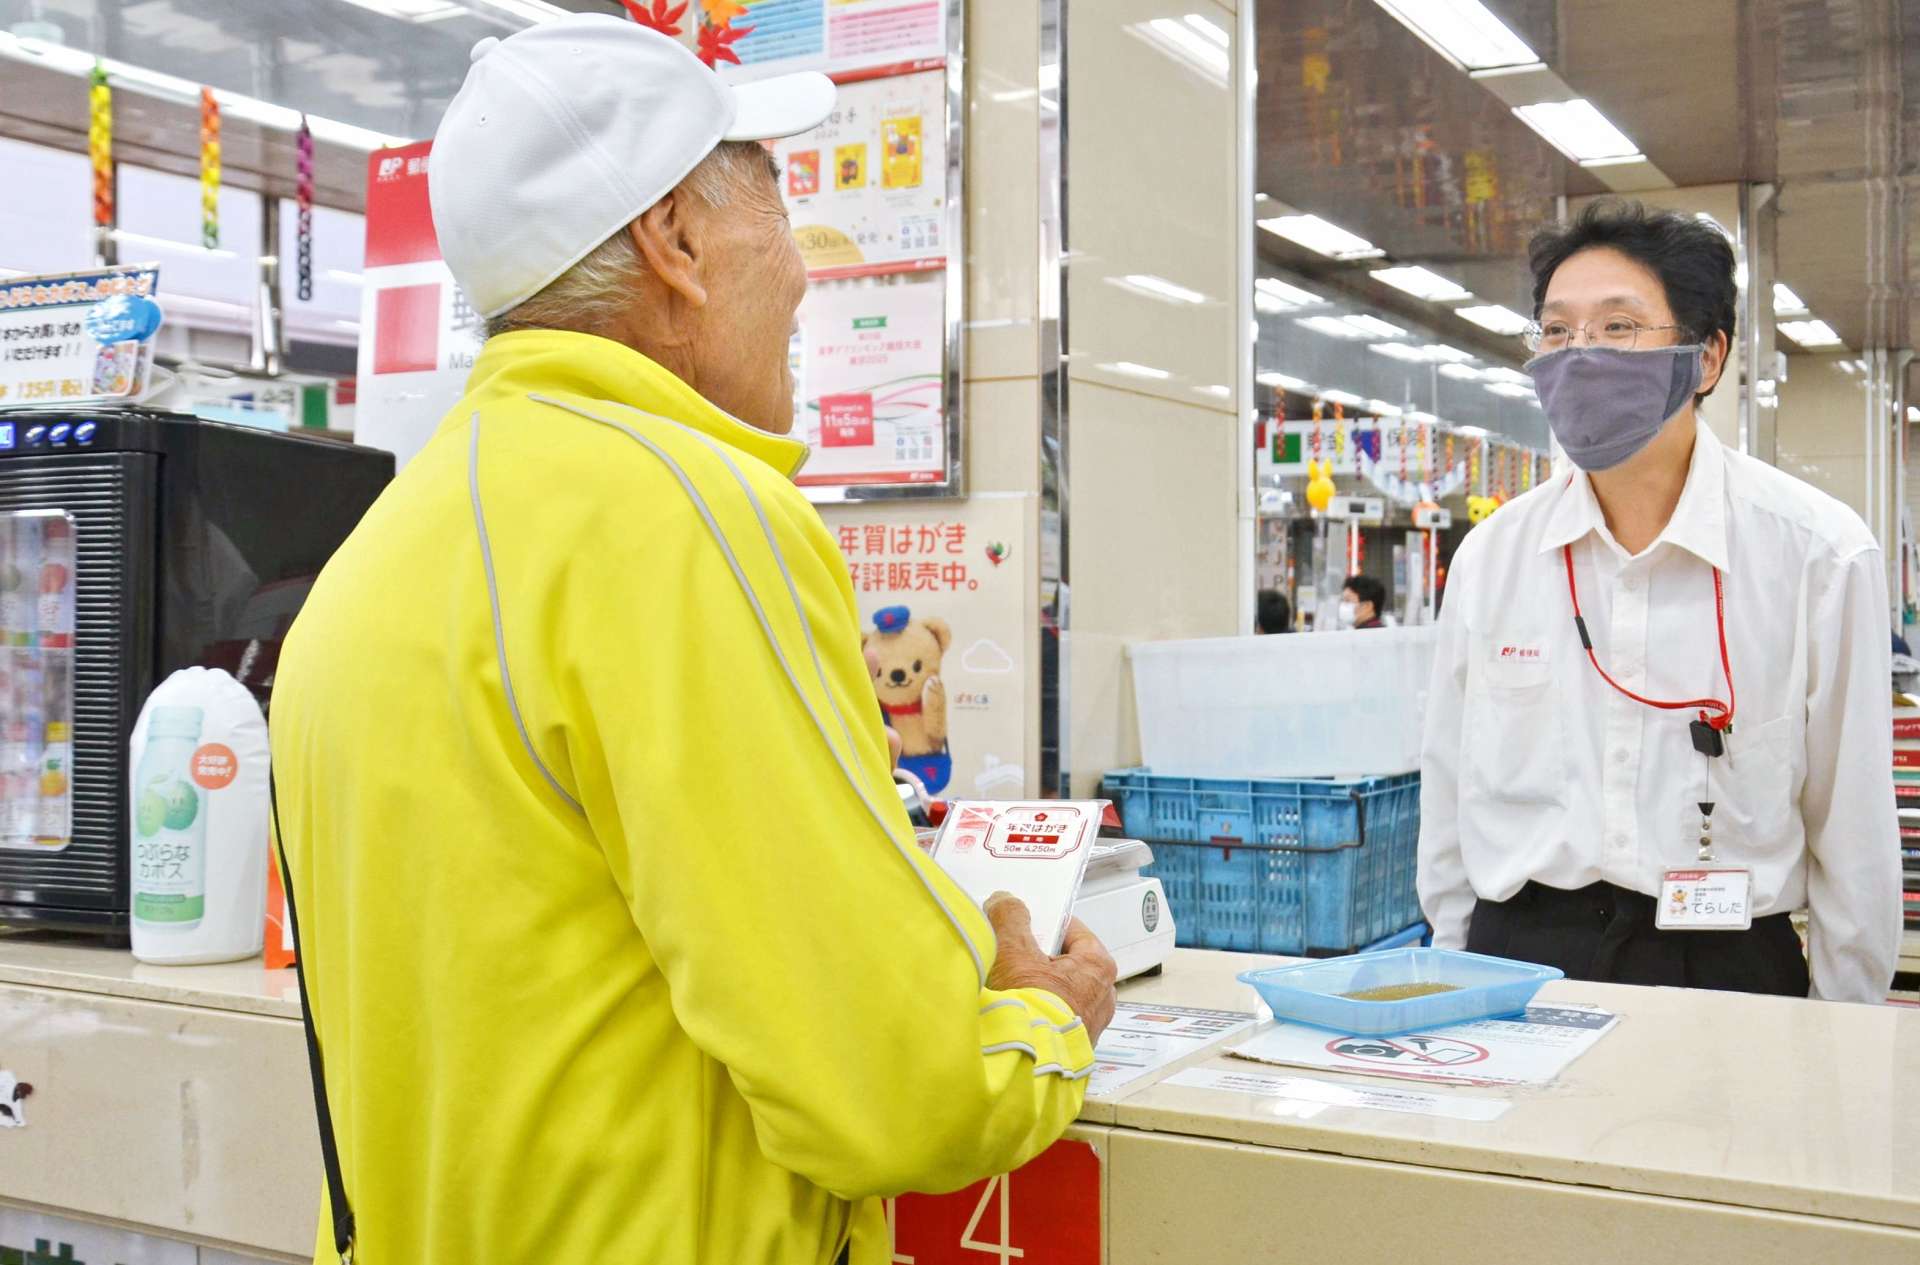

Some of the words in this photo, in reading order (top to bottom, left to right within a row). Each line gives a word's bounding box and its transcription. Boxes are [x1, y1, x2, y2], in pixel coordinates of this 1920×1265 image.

[838, 521, 966, 555] 年賀はがき
[138, 842, 191, 861] つぶらな
[1691, 902, 1743, 914] てらした
